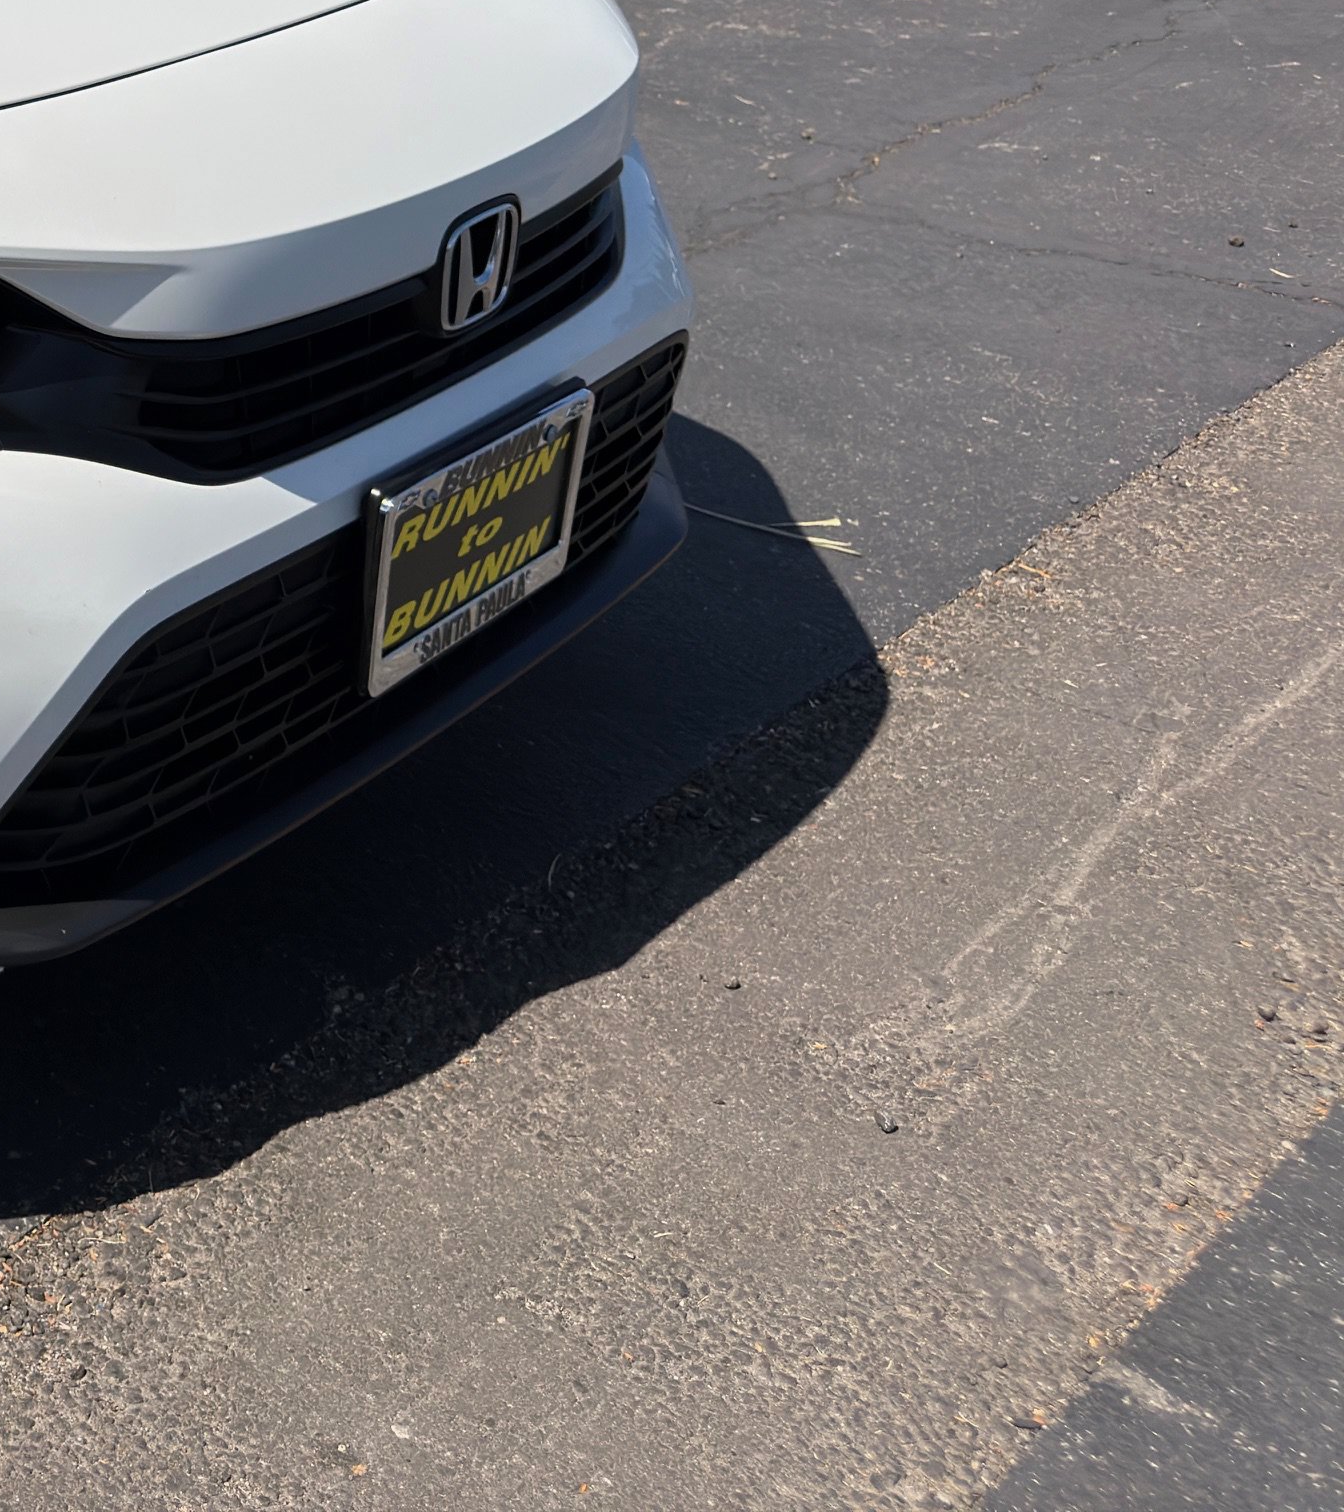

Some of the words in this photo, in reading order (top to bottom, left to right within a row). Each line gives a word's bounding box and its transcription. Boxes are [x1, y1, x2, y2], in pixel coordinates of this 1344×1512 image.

[391, 432, 571, 560] RUNNIN'
[457, 516, 503, 558] to
[383, 515, 552, 650] BUNNIN
